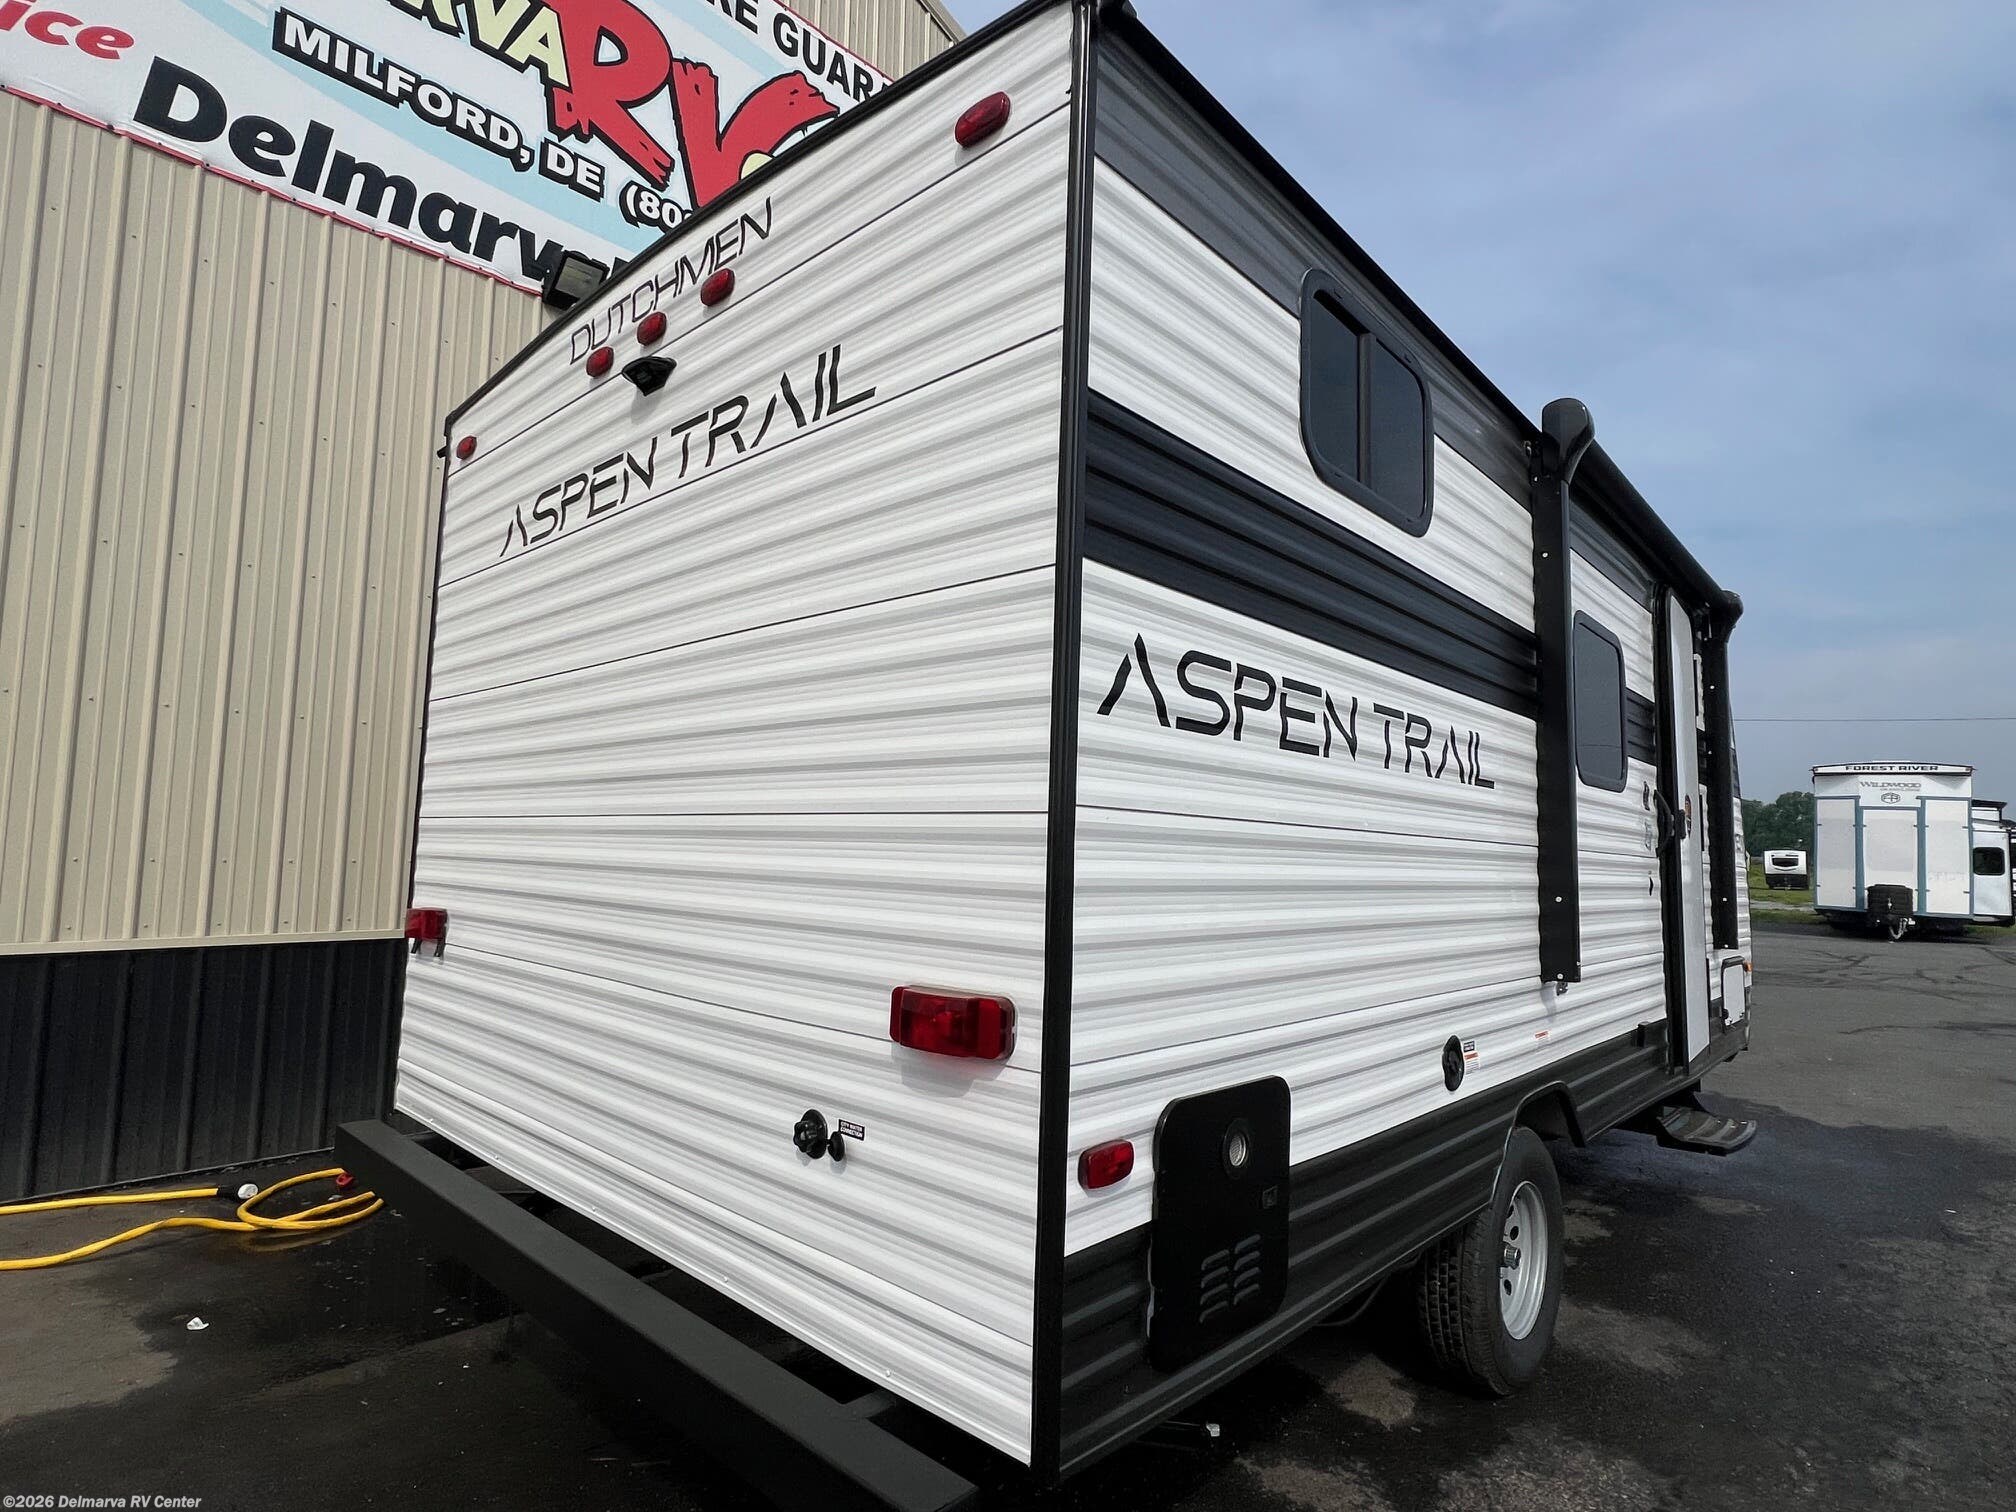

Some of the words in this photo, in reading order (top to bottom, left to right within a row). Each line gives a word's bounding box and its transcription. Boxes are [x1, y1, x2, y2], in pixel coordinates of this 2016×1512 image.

[281, 12, 533, 165] MILFORD,
[545, 138, 602, 194] DE
[625, 184, 693, 229] (80
[772, 12, 889, 104] GUAR
[133, 55, 591, 282] Delmarv
[570, 196, 772, 365] DUTCHMEN
[500, 436, 658, 557] ASPEN
[670, 343, 877, 478] TRAIL
[1096, 632, 1359, 762] ASPEN
[1373, 702, 1496, 790] TRAIL
